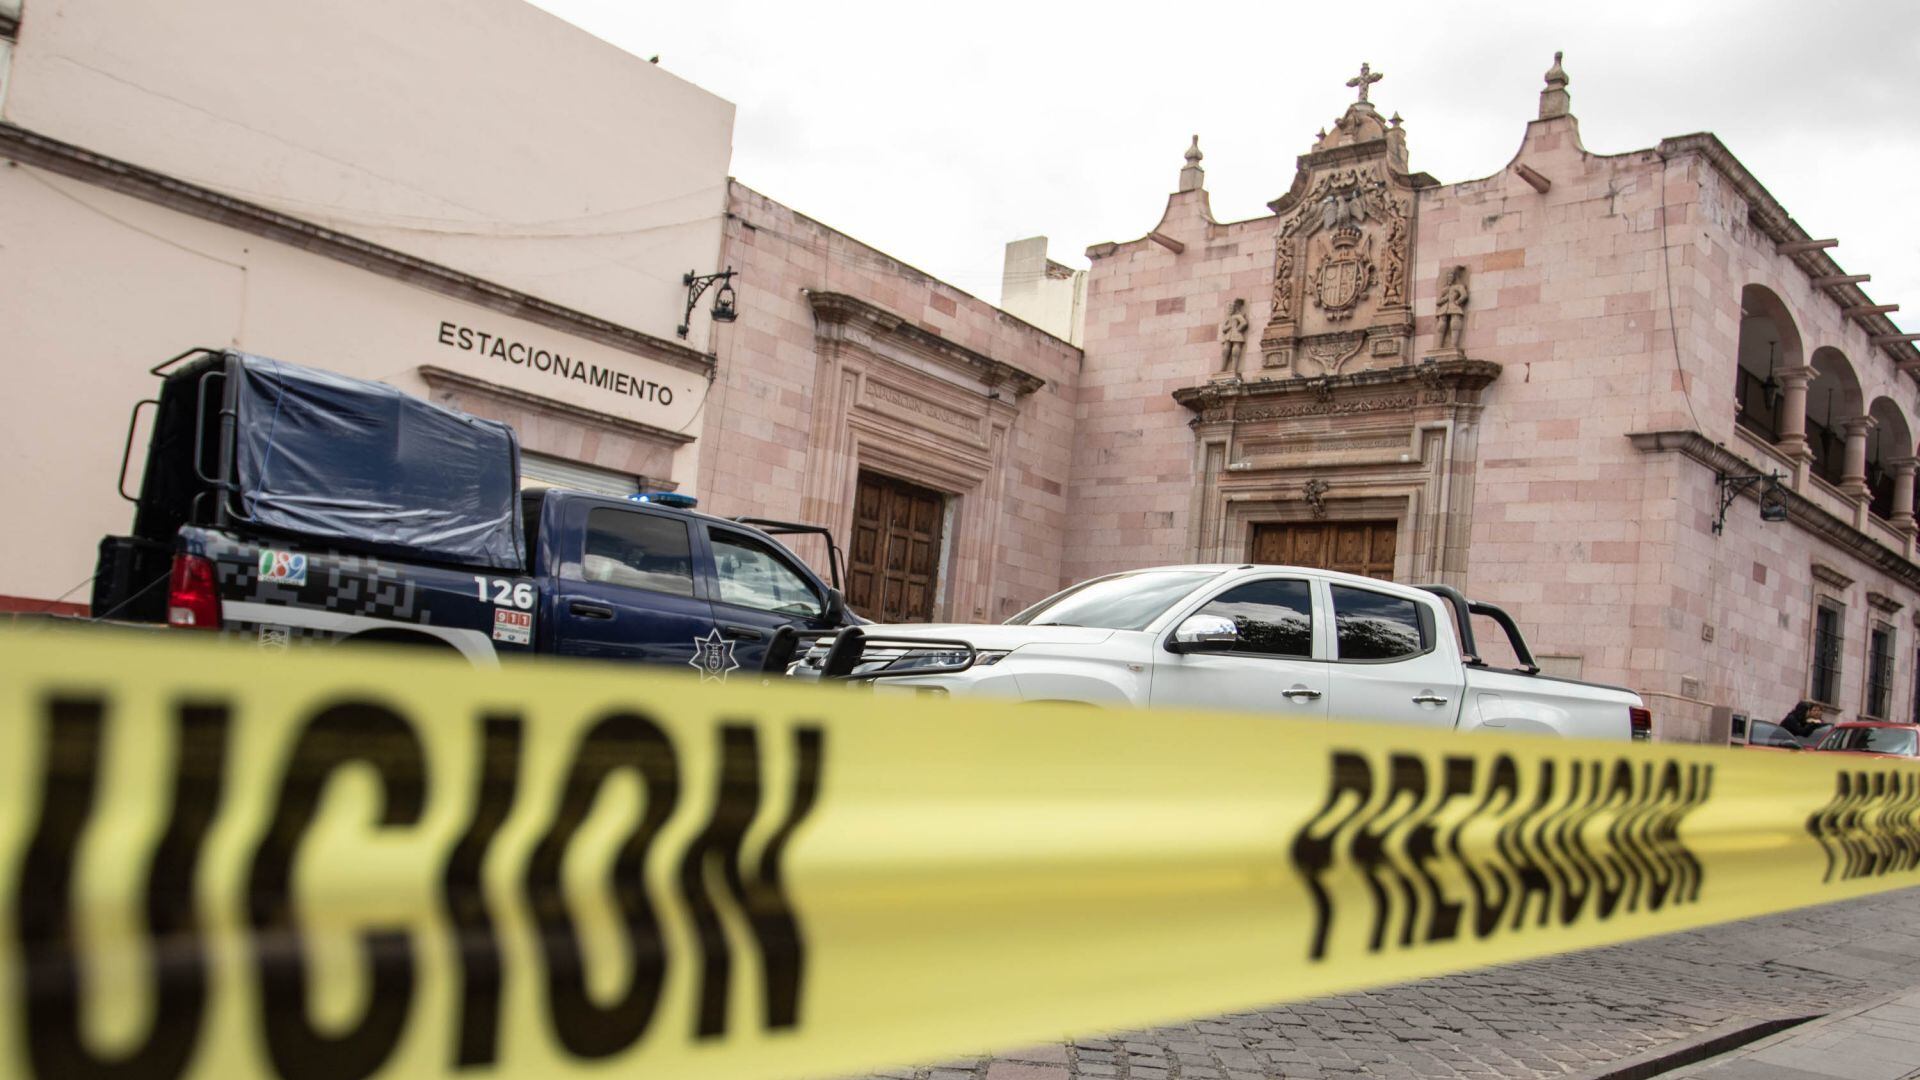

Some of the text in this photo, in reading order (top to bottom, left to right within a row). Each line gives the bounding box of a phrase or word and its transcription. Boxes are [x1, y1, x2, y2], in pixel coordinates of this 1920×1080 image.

[438, 321, 673, 406] ESTACIONAMIENTO
[259, 550, 304, 580] 089
[474, 575, 533, 609] 126
[498, 612, 528, 627] 911
